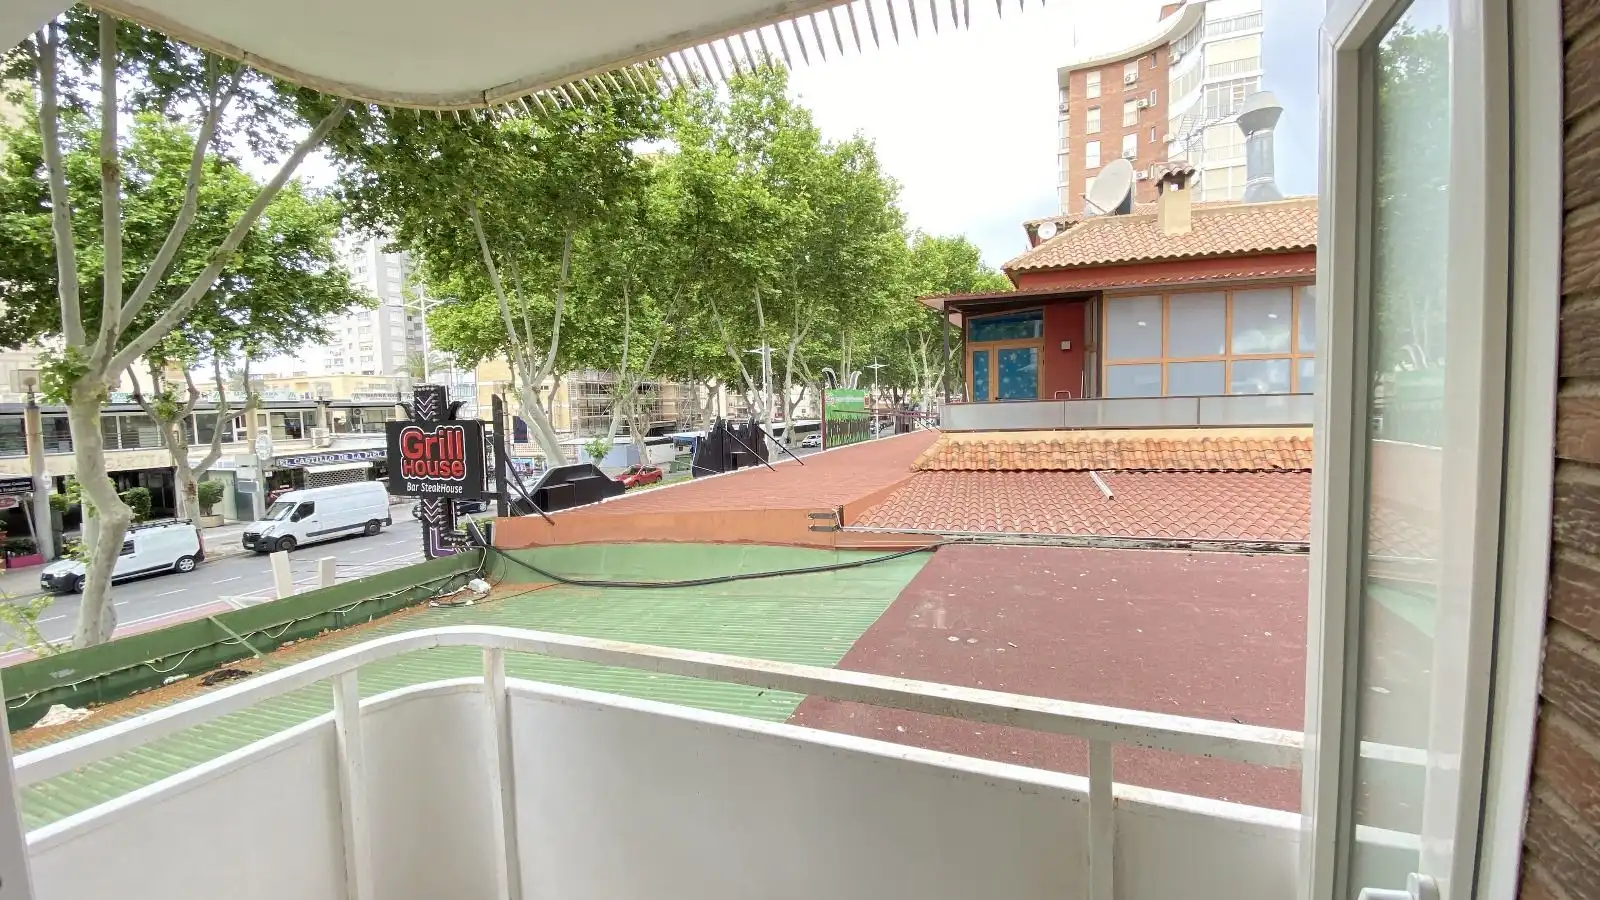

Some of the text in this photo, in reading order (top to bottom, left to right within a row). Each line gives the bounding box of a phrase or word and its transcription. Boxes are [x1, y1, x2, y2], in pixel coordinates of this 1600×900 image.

[403, 429, 463, 460] Grill
[407, 482, 463, 494] Bar SteakHouse
